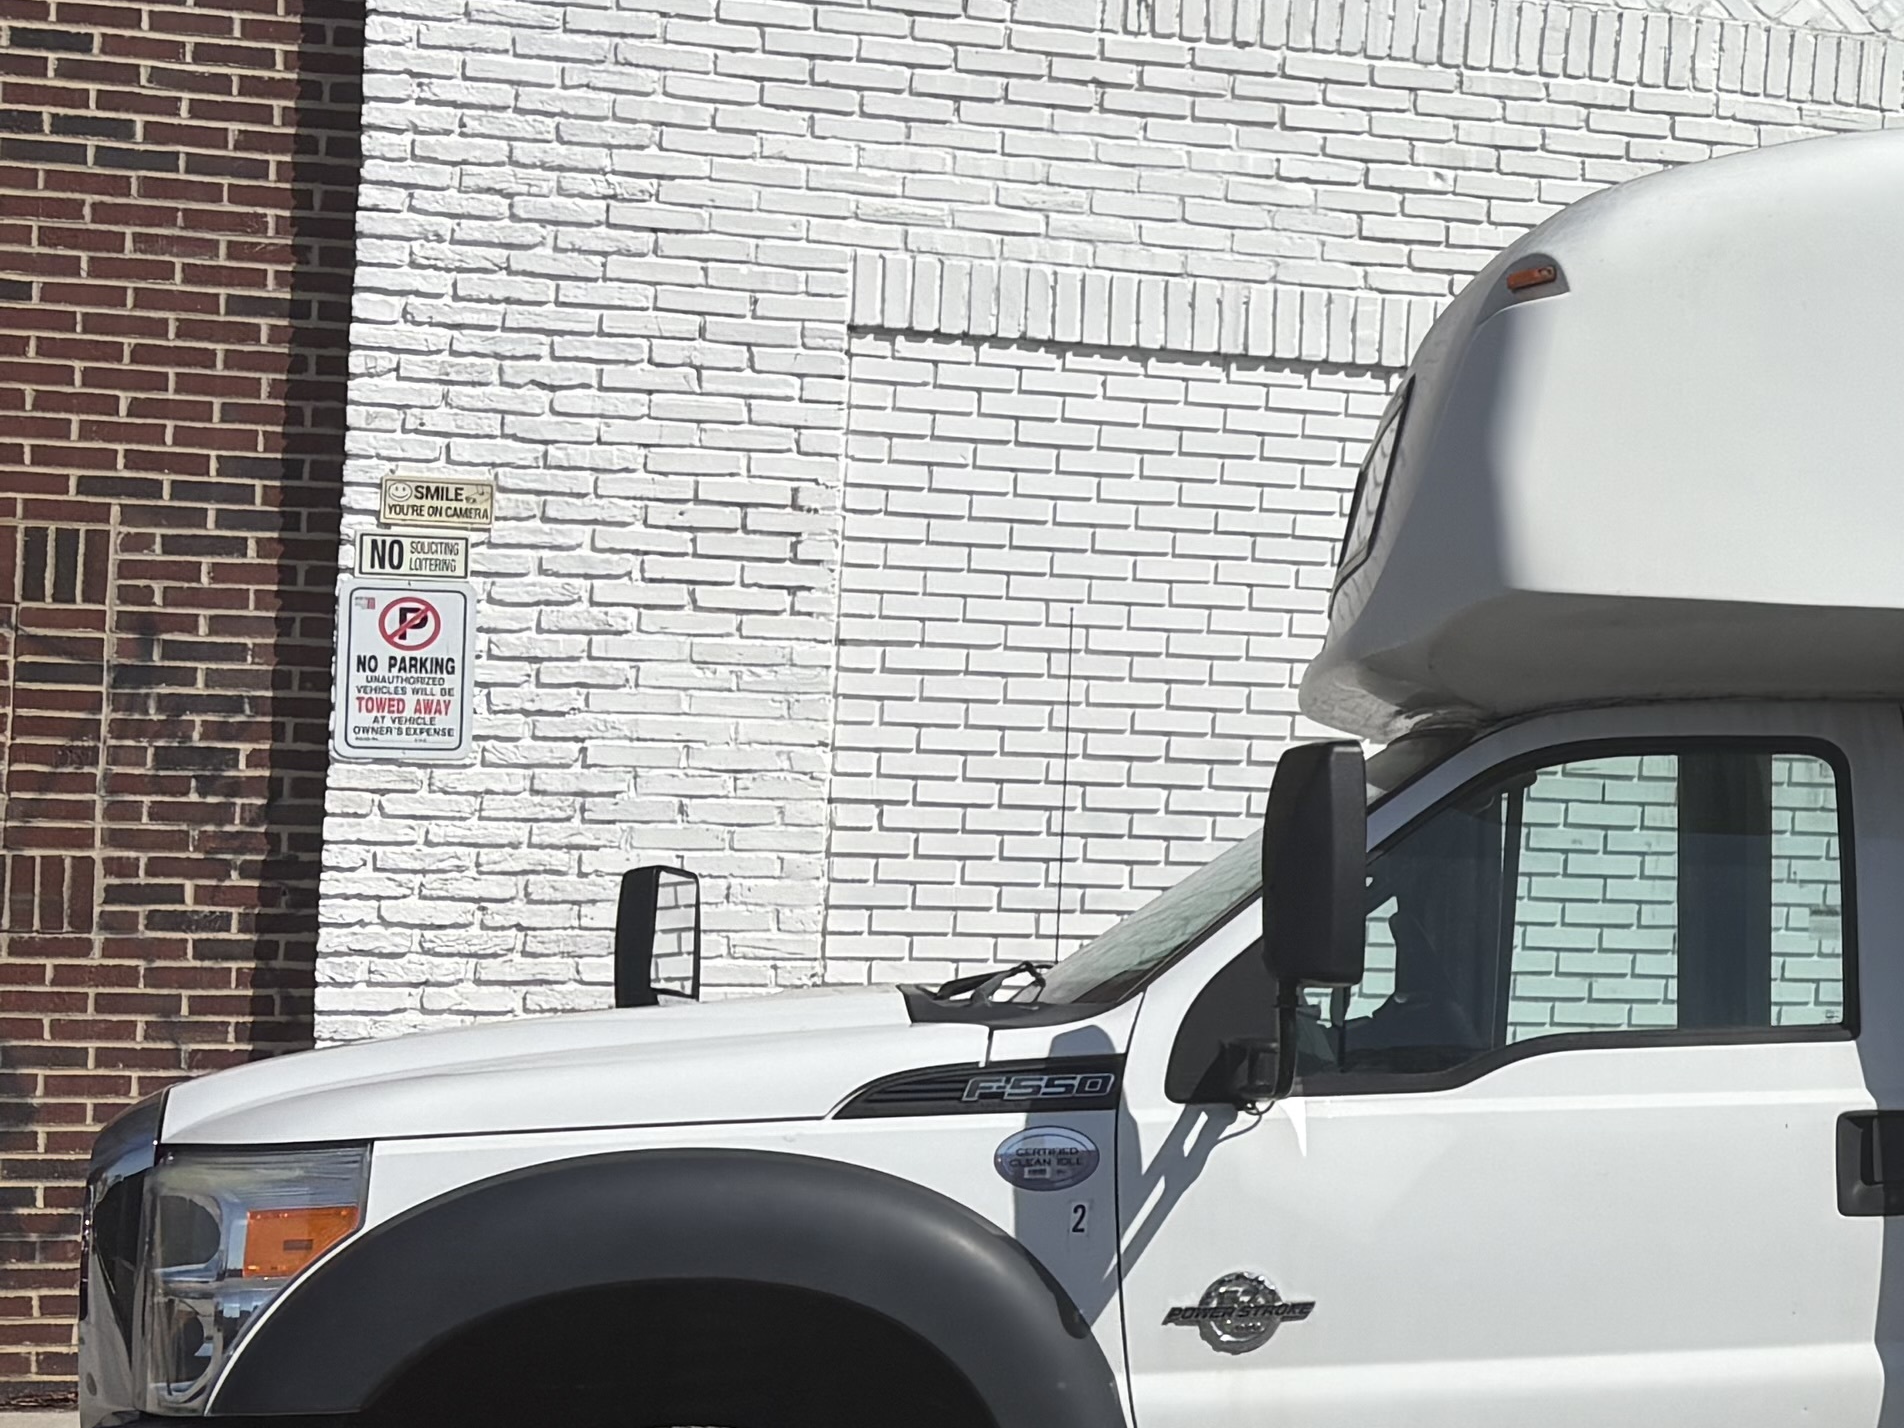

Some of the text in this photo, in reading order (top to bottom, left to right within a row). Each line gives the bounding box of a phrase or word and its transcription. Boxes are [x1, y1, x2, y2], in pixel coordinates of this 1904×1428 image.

[414, 485, 464, 502] SMILE
[388, 503, 489, 520] YOU'RE ON CAMERA
[370, 538, 404, 570] NO
[410, 540, 459, 556] SOLICITING
[409, 557, 456, 572] LOITERING
[356, 655, 455, 675] NO PARKING
[366, 675, 445, 686] UNAUTHORIZED
[355, 685, 455, 697] VEHICLES WILL BE
[356, 696, 451, 716] TOWED AWAY
[372, 715, 436, 726] AT VEHICLE
[353, 726, 455, 737] OWNER'S EXPENSE
[962, 1073, 1115, 1102] F-550
[1015, 1147, 1079, 1157] CERTIFIED
[1009, 1157, 1052, 1167] CLEAN
[1072, 1204, 1087, 1233] 2
[1167, 1302, 1312, 1320] POWER STROKE
